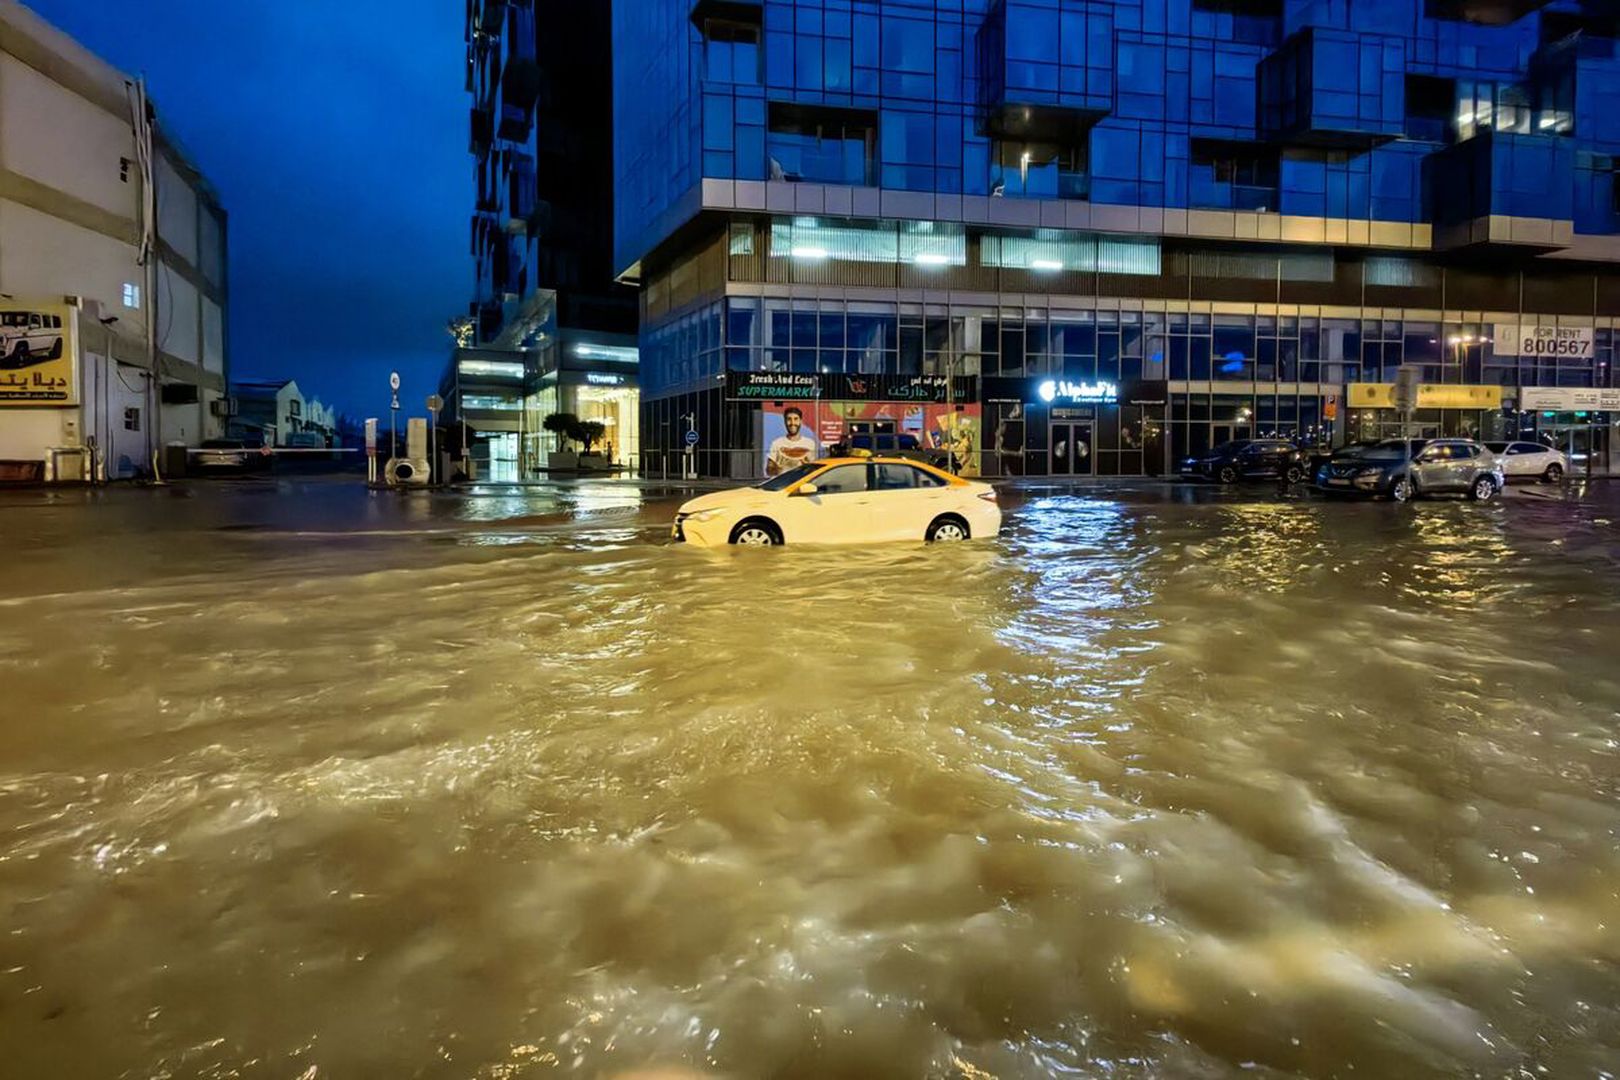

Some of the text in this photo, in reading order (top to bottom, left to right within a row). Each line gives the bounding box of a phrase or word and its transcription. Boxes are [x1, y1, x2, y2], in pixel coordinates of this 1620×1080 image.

[1533, 327, 1581, 340] FOR RENT
[1523, 338, 1591, 355] 800567
